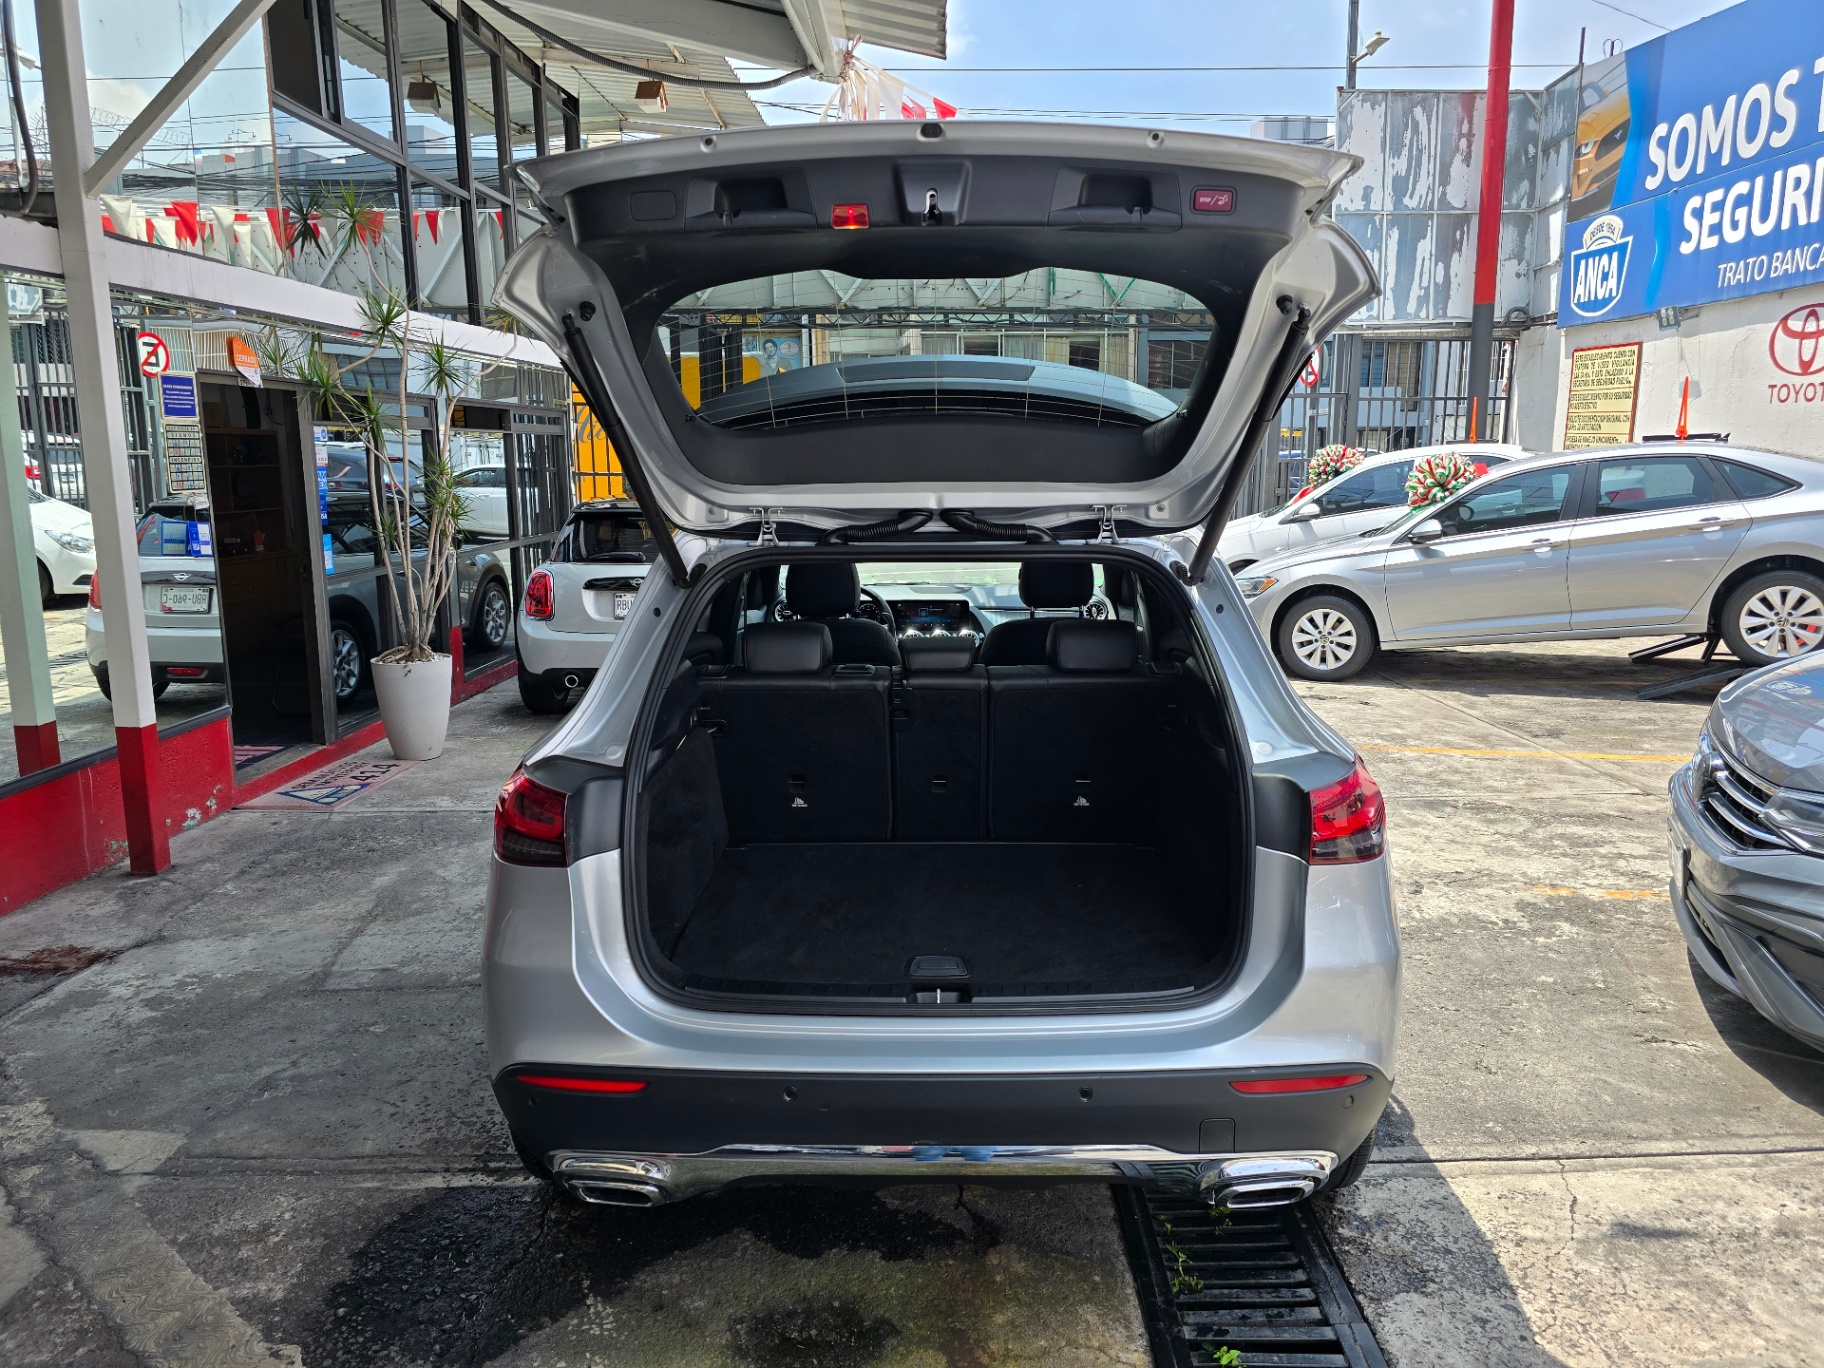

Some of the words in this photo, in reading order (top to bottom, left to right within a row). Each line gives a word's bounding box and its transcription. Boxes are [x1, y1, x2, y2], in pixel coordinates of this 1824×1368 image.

[1644, 68, 1799, 190] SOMOS
[1573, 251, 1618, 304] ANCA
[1717, 254, 1768, 288] TRATO
